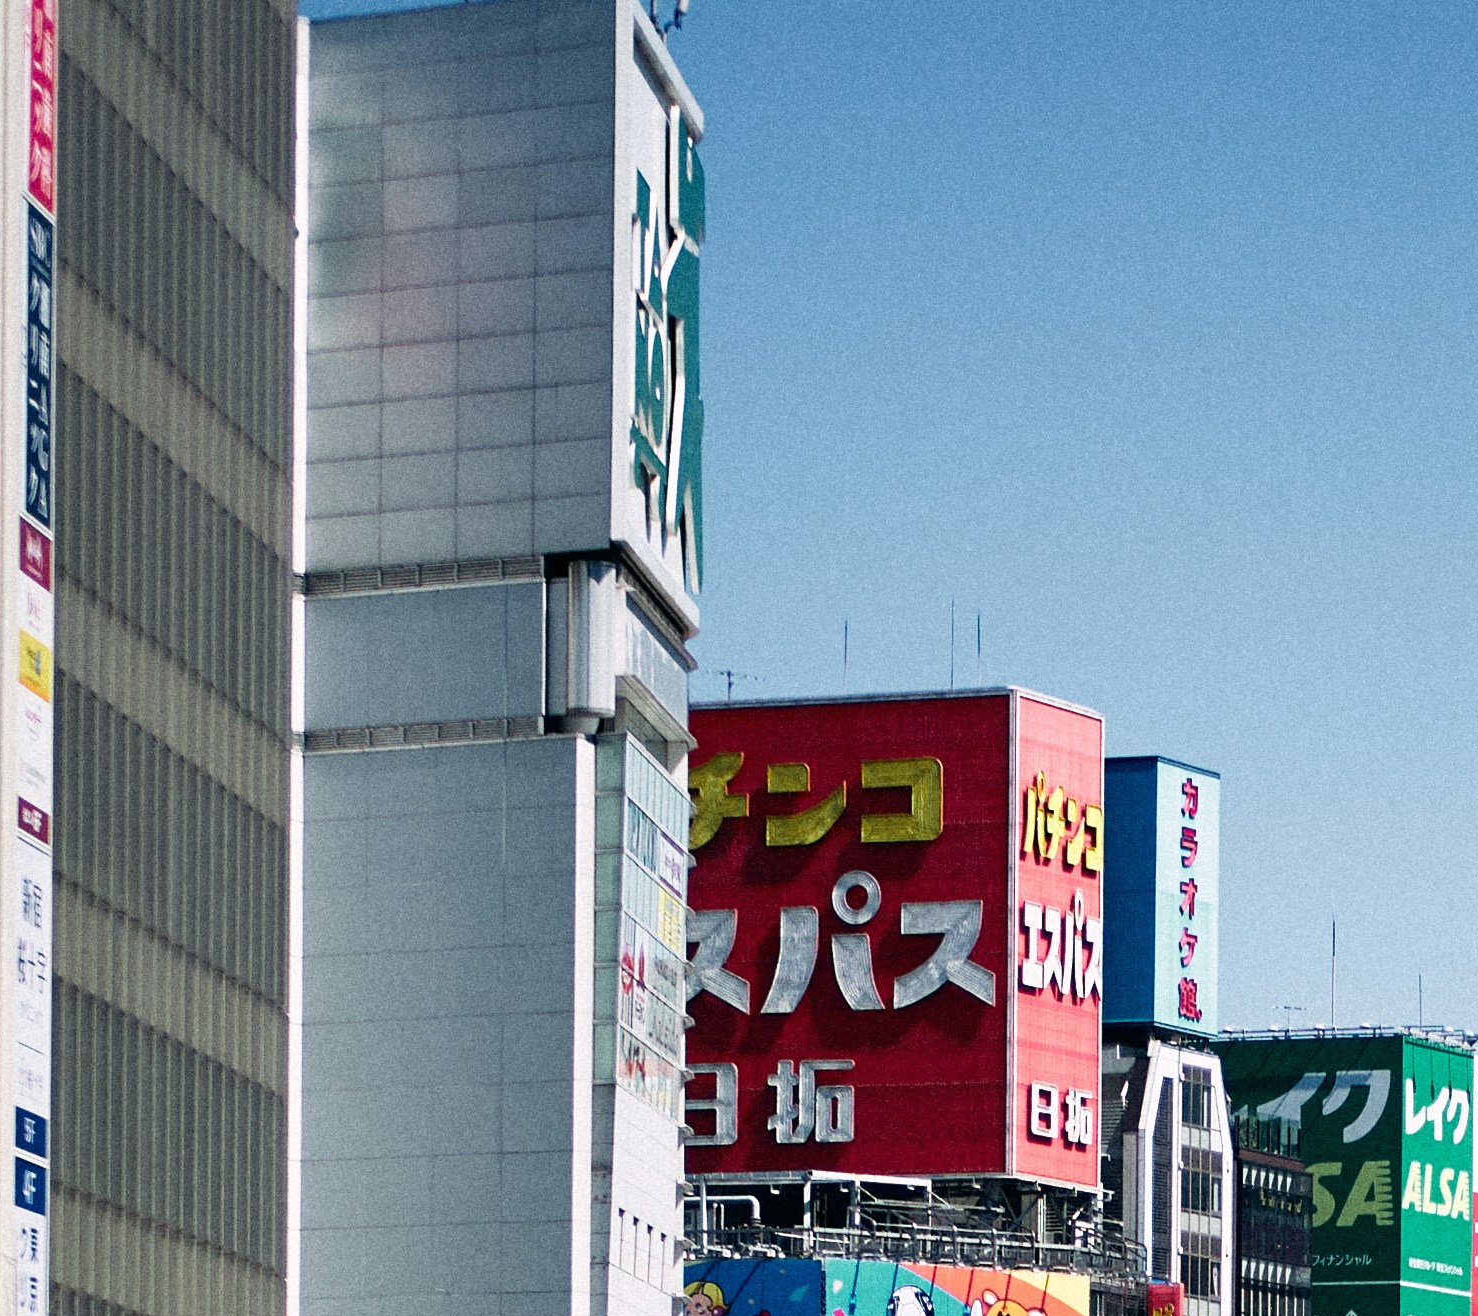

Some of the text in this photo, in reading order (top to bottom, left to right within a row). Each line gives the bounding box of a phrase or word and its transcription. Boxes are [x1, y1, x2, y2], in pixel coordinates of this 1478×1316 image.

[1023, 769, 1103, 873] パチンコ
[1177, 777, 1202, 1023] カラオケ館
[1022, 888, 1103, 1001] エスパス
[1030, 1080, 1093, 1146] 日拓
[1404, 1077, 1471, 1146] レイク
[1402, 1160, 1471, 1222] ALSA
[1312, 1253, 1372, 1267] フィナンシャル
